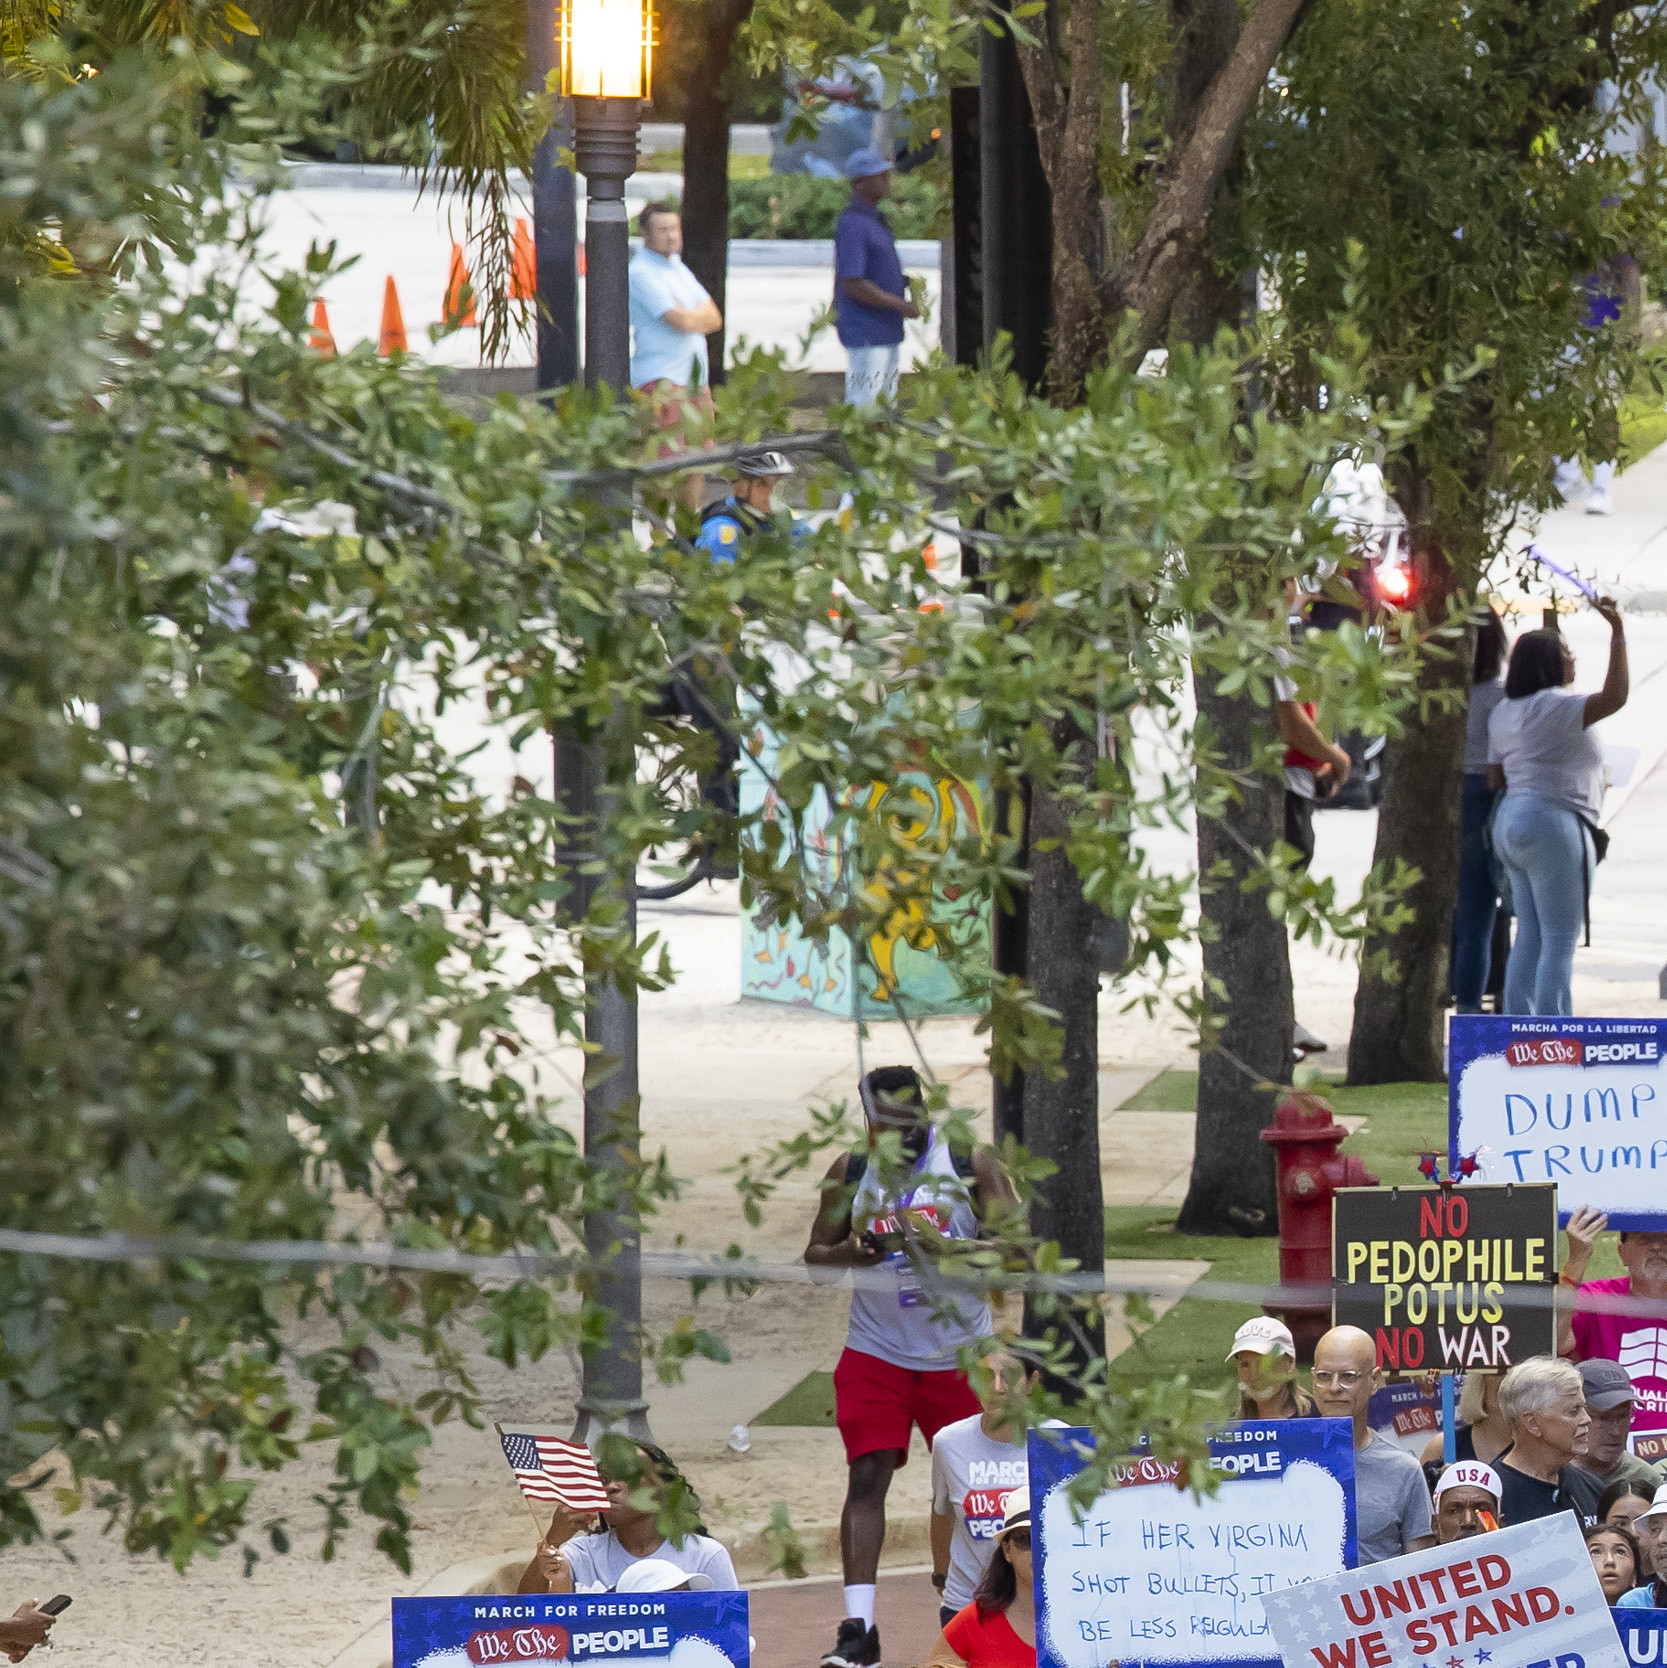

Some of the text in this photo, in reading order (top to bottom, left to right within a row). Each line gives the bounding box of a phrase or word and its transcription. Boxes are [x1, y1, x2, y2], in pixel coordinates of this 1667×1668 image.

[1505, 1083, 1656, 1136] DUMP
[1420, 1195, 1469, 1239] NO
[1347, 1238, 1546, 1285] PEDOPHILE
[1384, 1282, 1504, 1327] POTUS
[1376, 1326, 1512, 1370] NO WAR
[1456, 1468, 1491, 1487] USA
[1072, 1519, 1111, 1548] IF
[1142, 1519, 1195, 1550] HER
[1072, 1570, 1130, 1594] SHOT
[474, 1603, 665, 1618] MARCH FOR FREEDOM
[474, 1626, 669, 1662] We The PEOPLE
